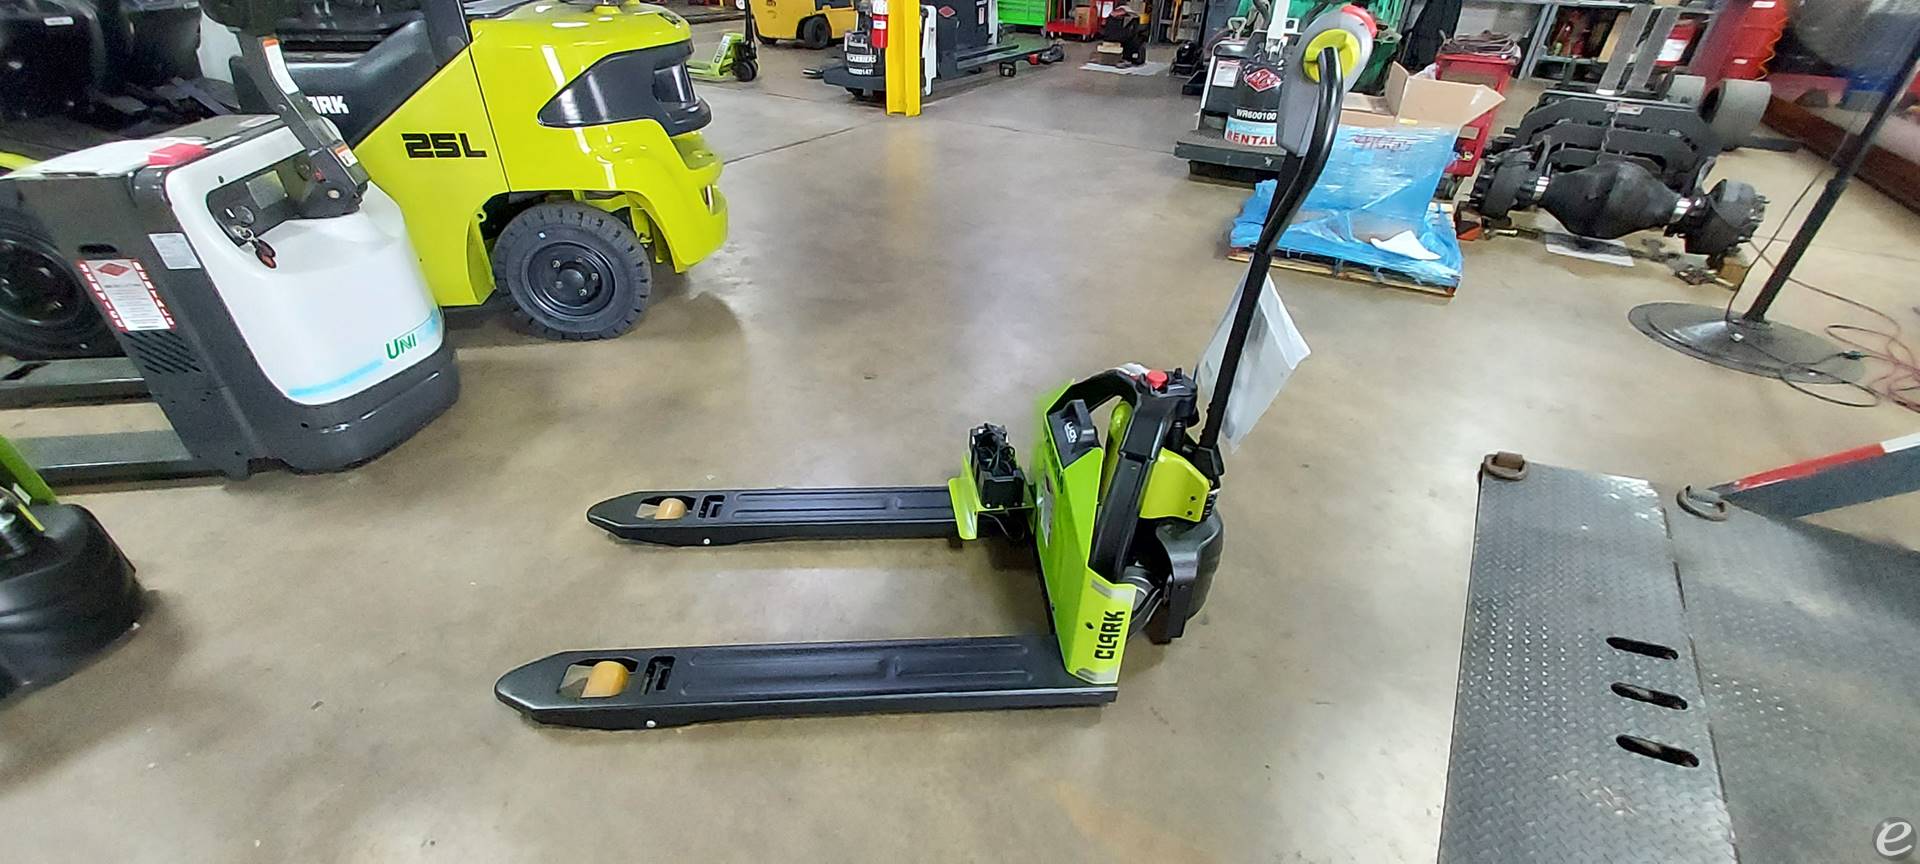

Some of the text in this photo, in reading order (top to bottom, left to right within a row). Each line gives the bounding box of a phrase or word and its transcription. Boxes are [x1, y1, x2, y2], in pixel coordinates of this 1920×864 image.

[307, 95, 350, 114] ARK
[1236, 108, 1277, 120] WR600100
[401, 132, 487, 158] 25L
[1227, 131, 1275, 145] RENTAL
[385, 332, 417, 360] UNI
[1094, 610, 1125, 660] CLARK
